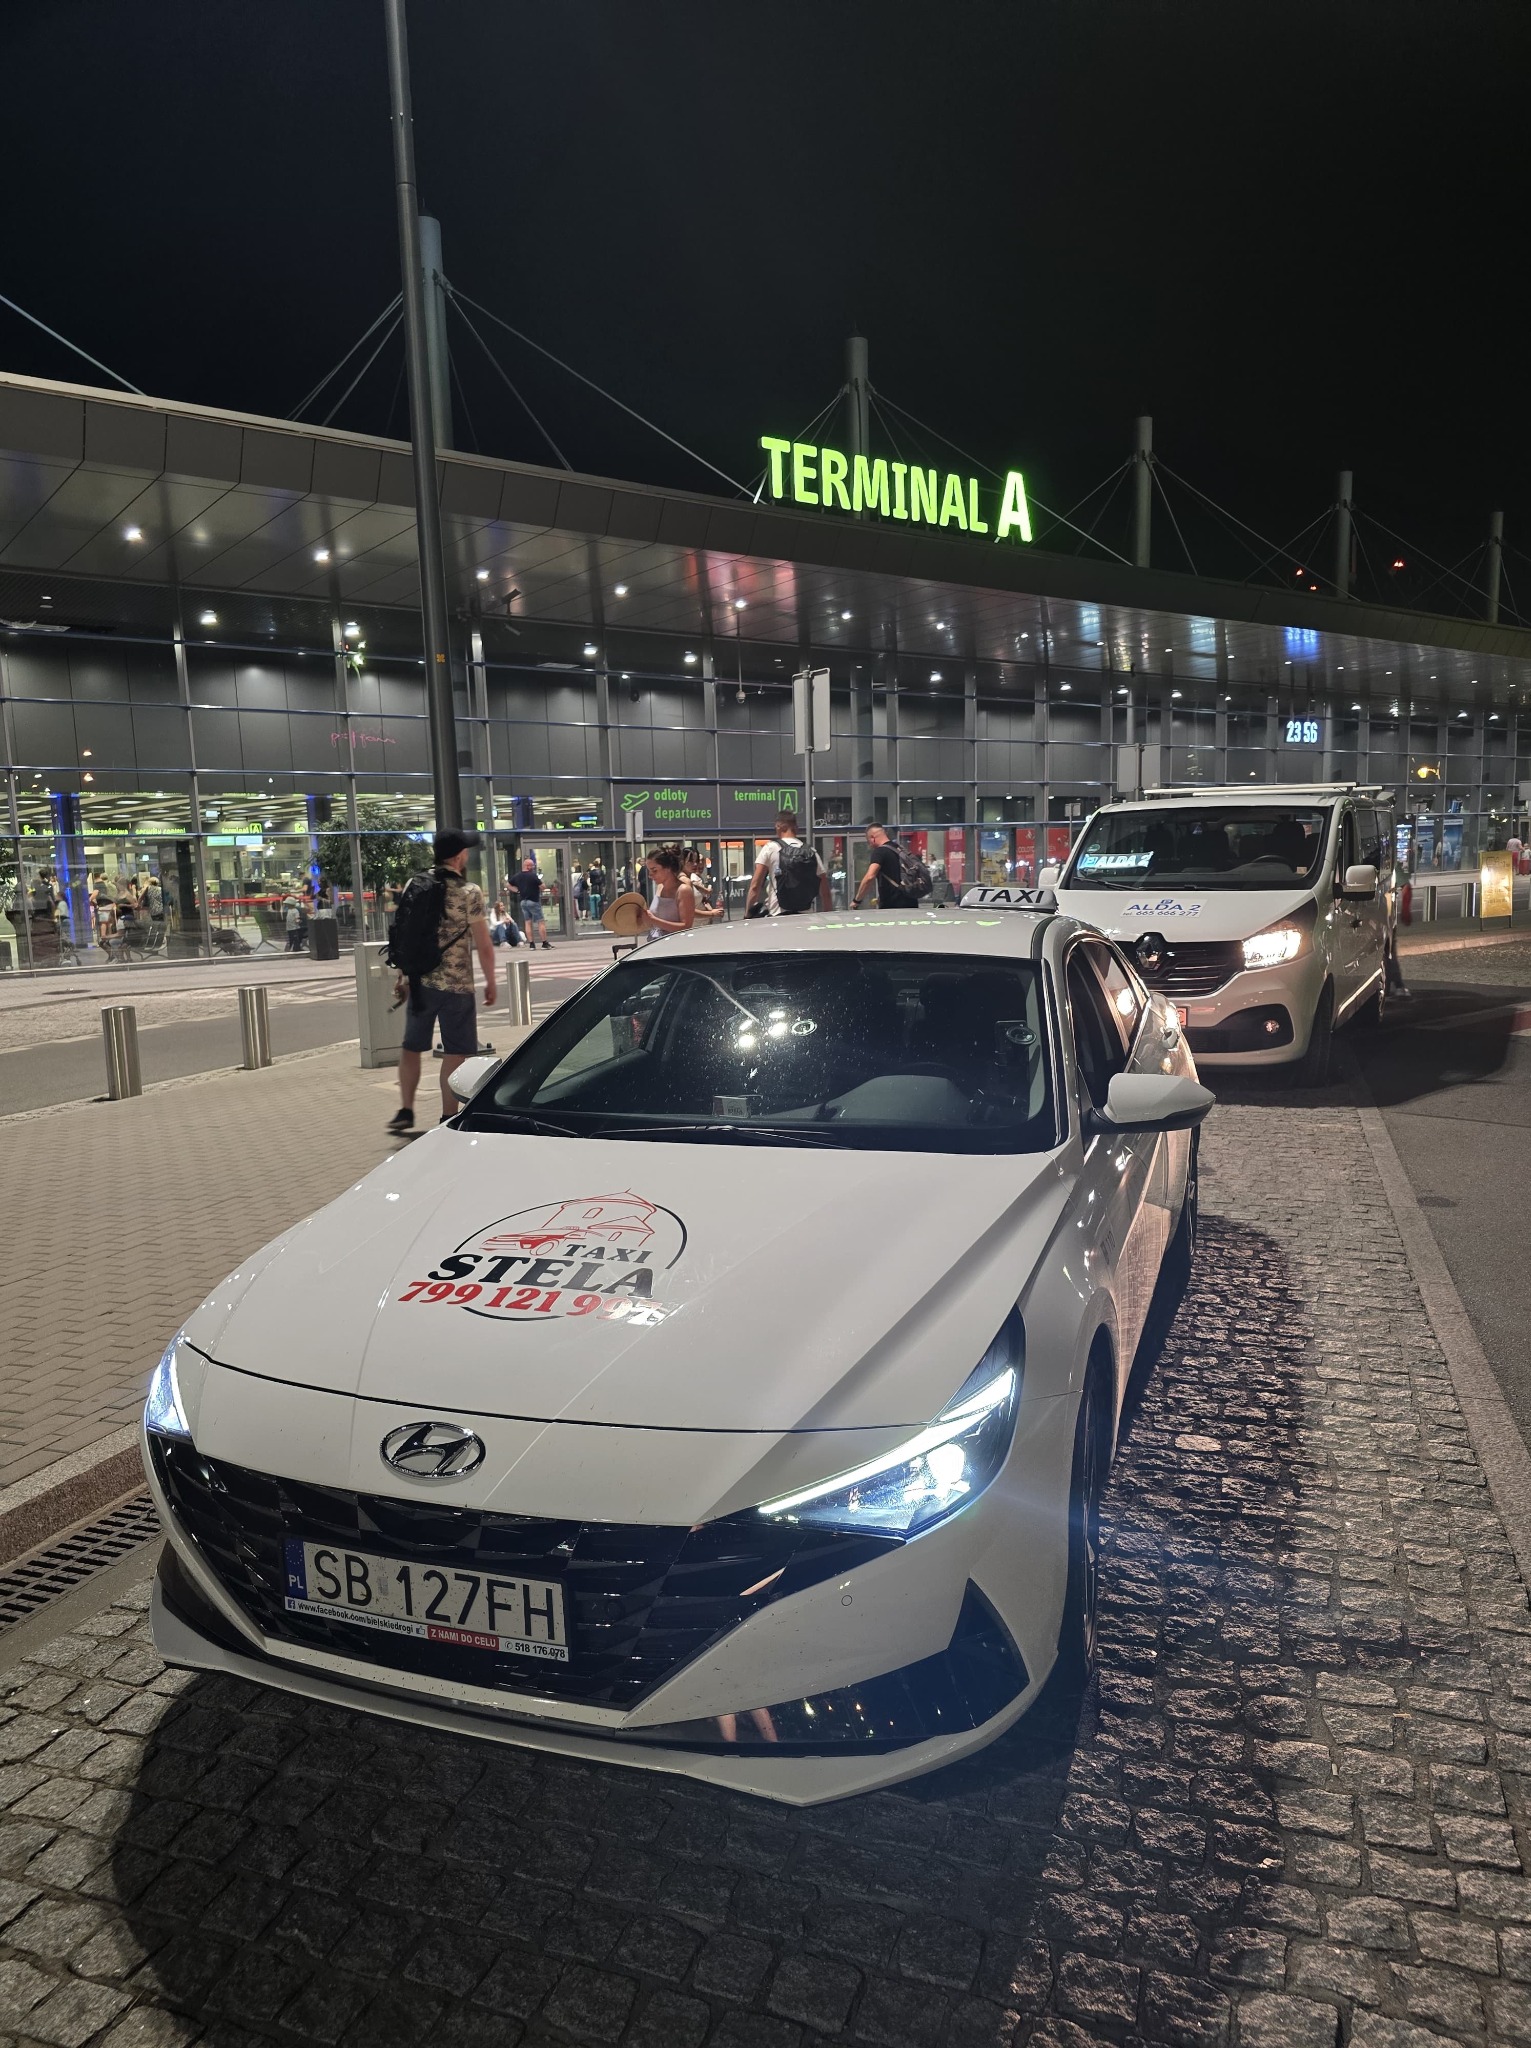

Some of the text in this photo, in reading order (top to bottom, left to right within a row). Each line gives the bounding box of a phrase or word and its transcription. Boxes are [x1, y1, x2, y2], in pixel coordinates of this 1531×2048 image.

[761, 436, 1033, 543] TERMINAL A
[653, 788, 794, 811] odloty terminal A
[654, 806, 712, 821] departures
[977, 888, 1045, 903] TAXI
[562, 1243, 653, 1264] TAXI
[427, 1253, 654, 1299] STELA
[397, 1281, 484, 1305] 799
[484, 1286, 562, 1313] 121
[288, 1575, 304, 1590] PL
[313, 1549, 556, 1641] SB 127FH
[430, 1628, 496, 1648] Z NAMI DO CELU
[514, 1643, 531, 1653] 518
[532, 1646, 548, 1657] 176
